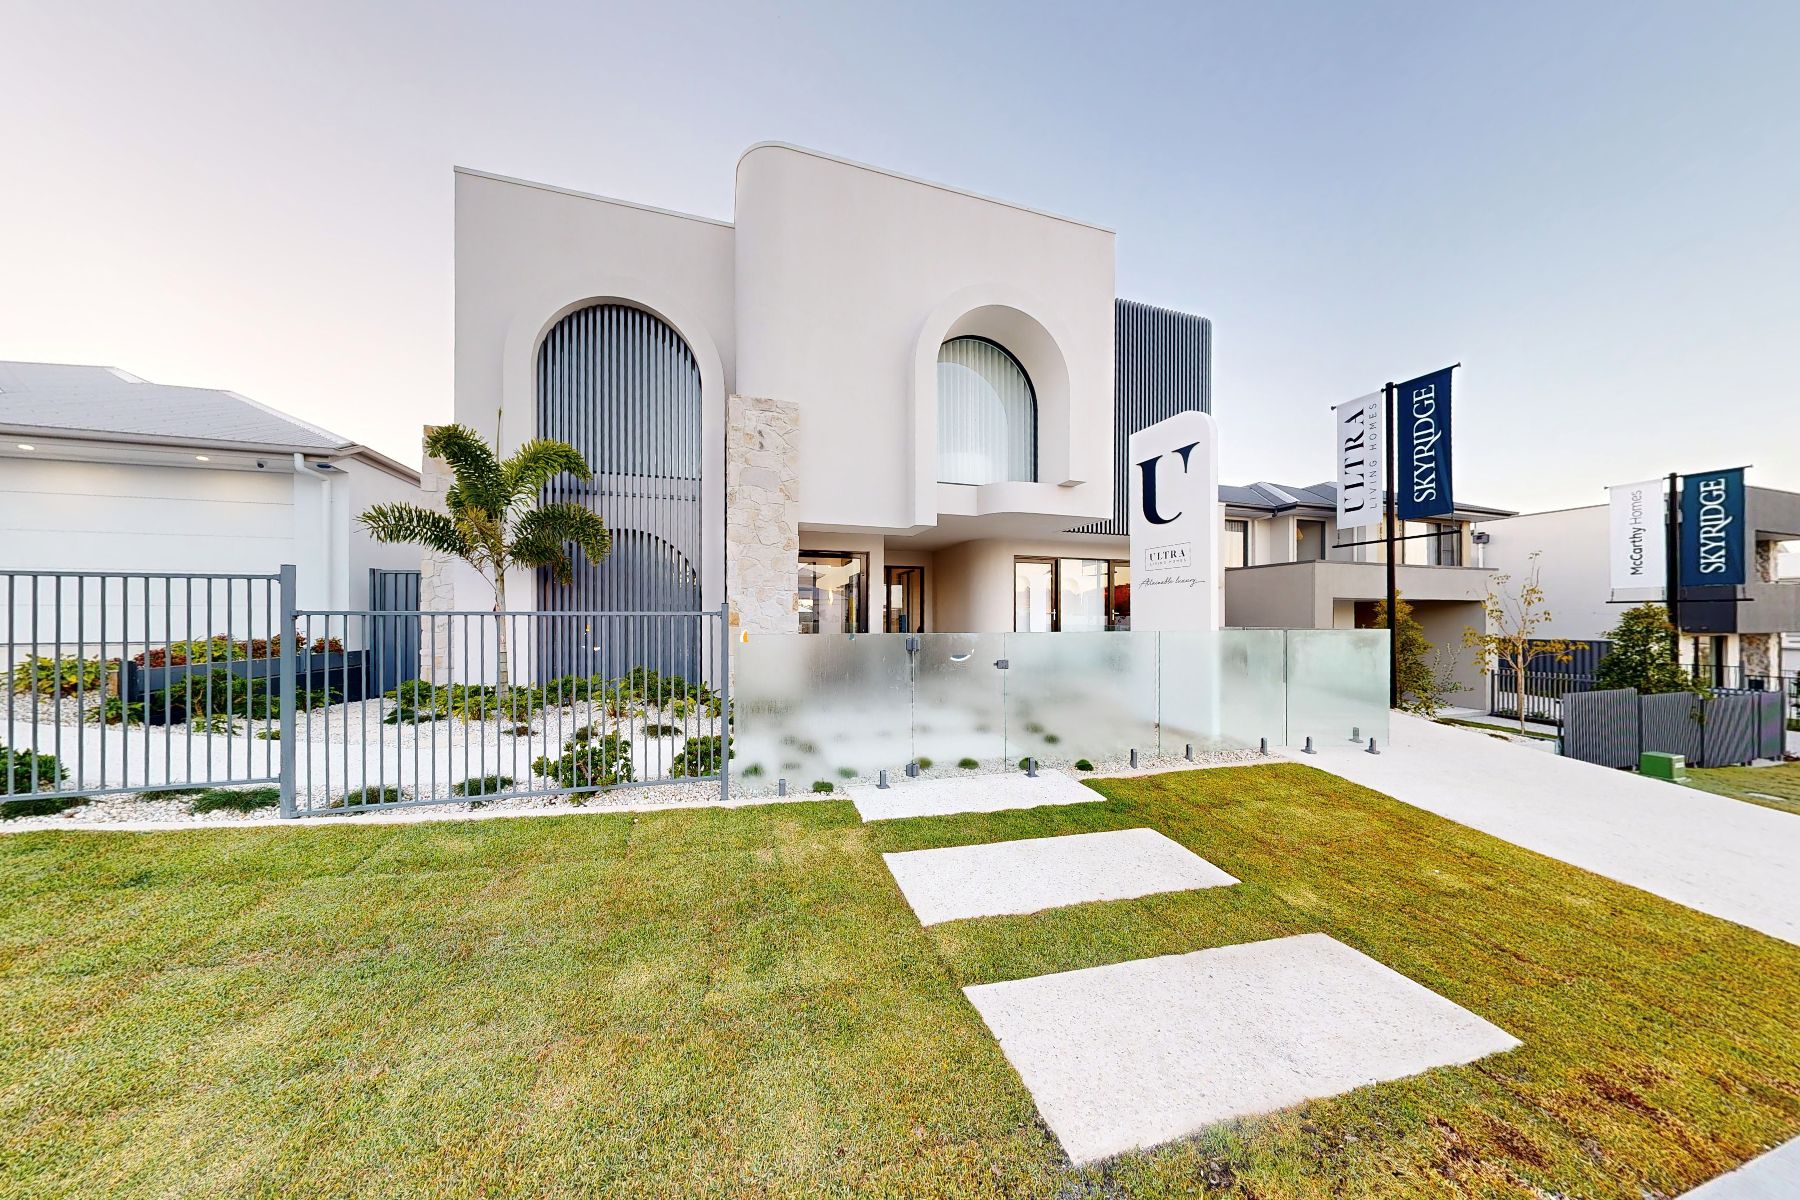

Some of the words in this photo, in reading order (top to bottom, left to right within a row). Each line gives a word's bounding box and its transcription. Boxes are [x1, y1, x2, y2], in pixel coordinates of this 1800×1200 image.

[1369, 403, 1378, 451] HOMES
[1413, 384, 1442, 503] SKYRIDGE
[1344, 408, 1365, 515] ULTRA
[1369, 460, 1378, 510] LIVING
[1630, 490, 1643, 526] Homes
[1699, 479, 1733, 574] SKYRIDGE
[1149, 549, 1186, 561] ULTRA
[1629, 527, 1646, 576] McCarthy
